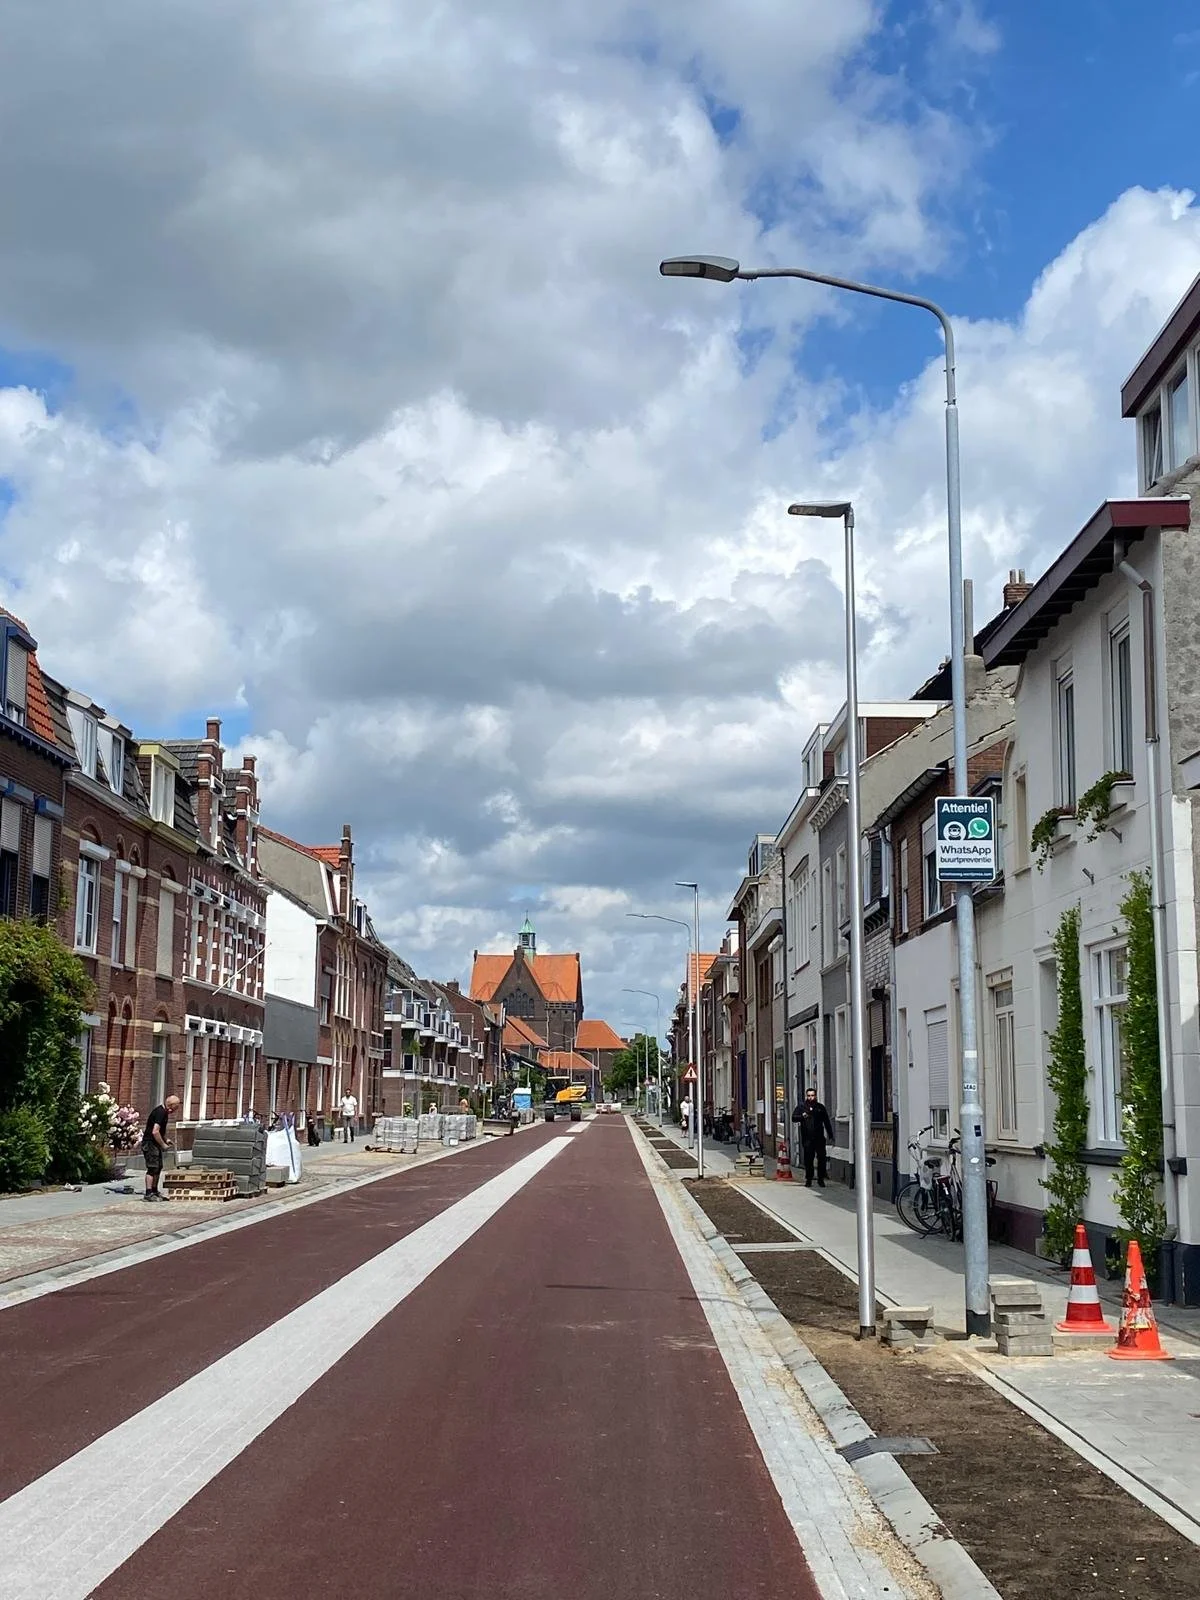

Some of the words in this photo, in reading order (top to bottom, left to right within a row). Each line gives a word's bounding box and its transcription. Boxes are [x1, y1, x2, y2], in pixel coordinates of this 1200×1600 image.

[941, 803, 988, 813] Attentie!
[940, 845, 992, 855] WhatsApp
[940, 856, 992, 864] buurtpreventie
